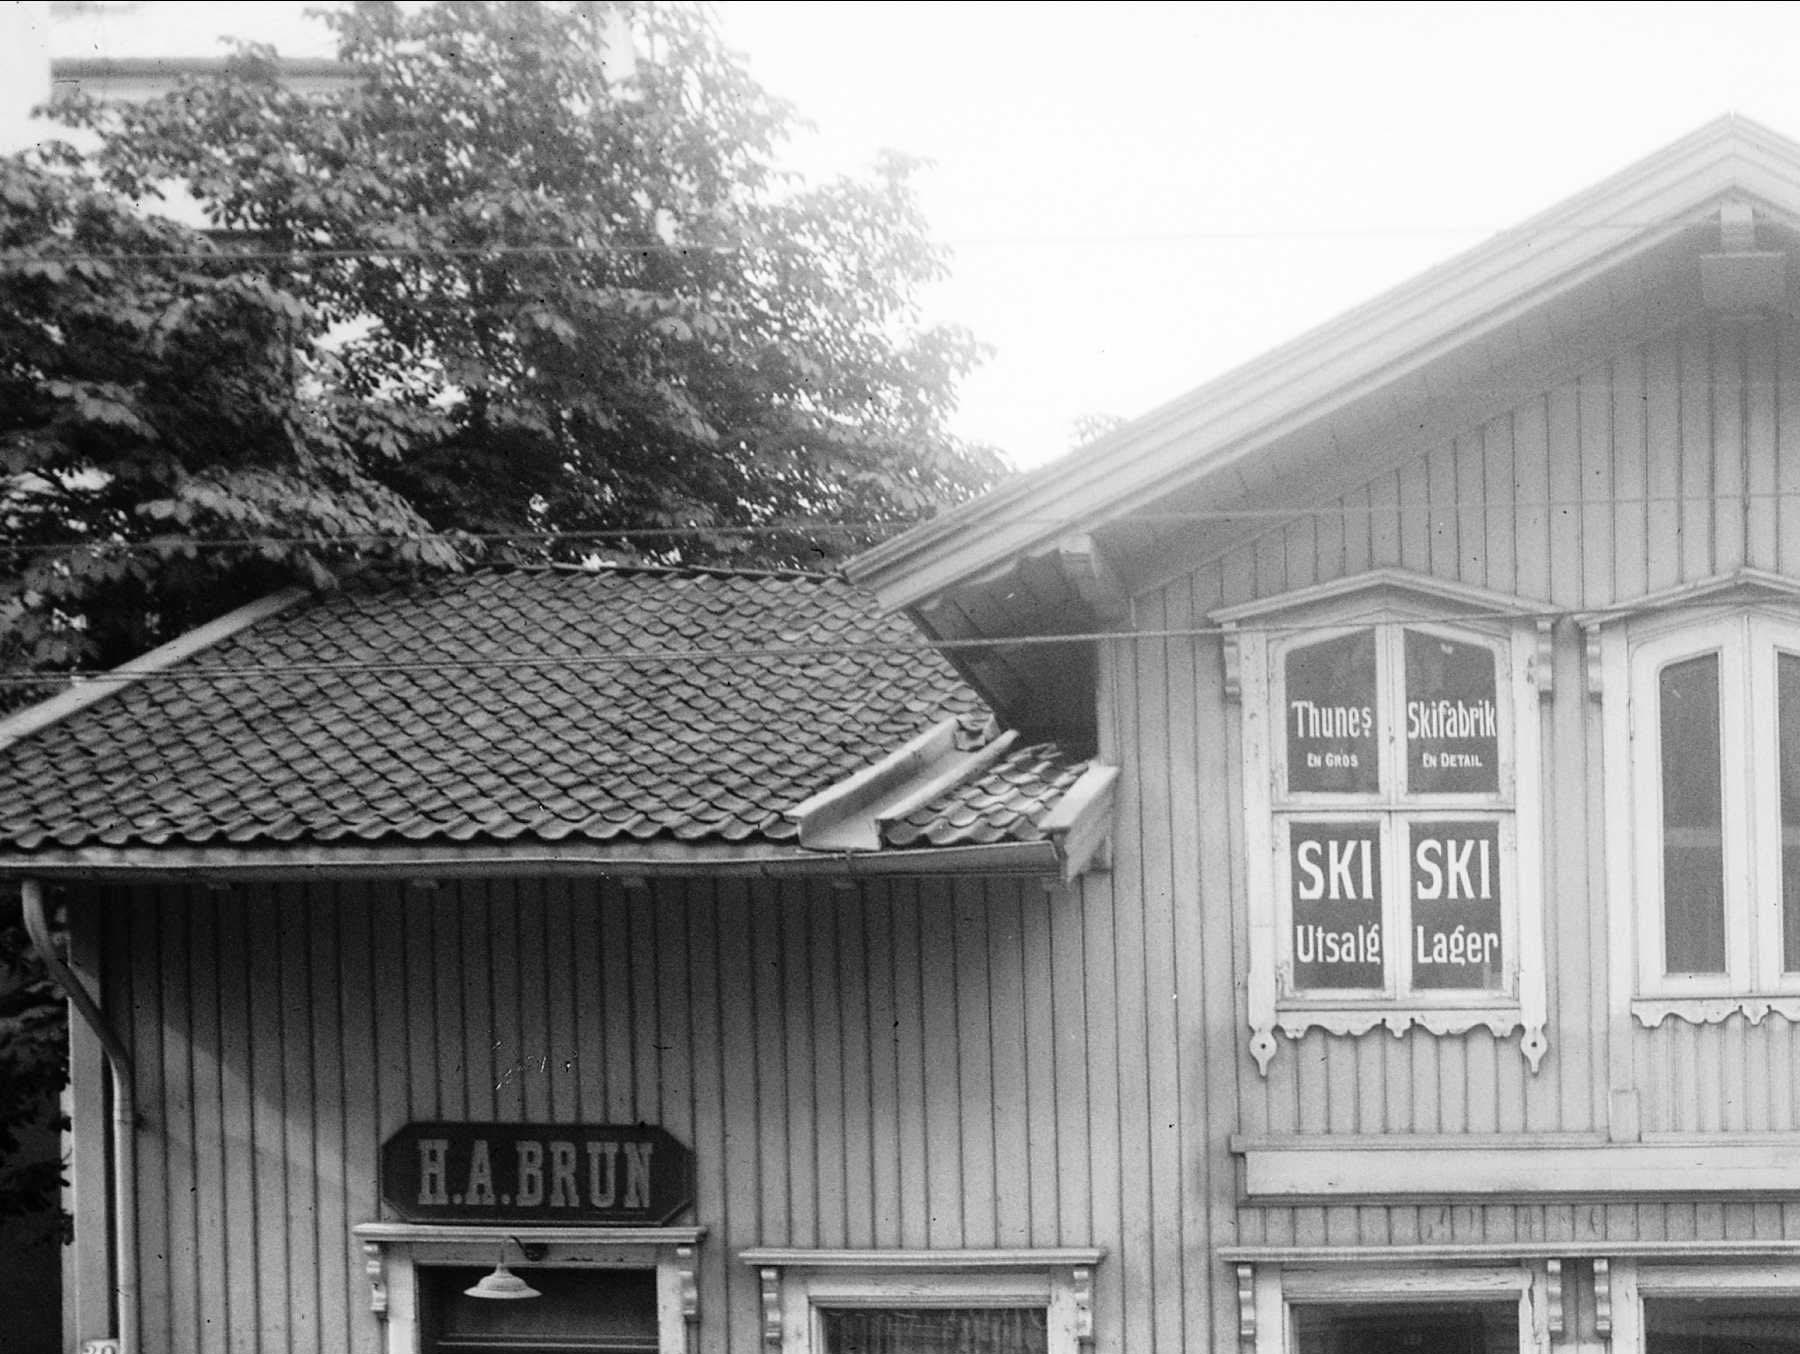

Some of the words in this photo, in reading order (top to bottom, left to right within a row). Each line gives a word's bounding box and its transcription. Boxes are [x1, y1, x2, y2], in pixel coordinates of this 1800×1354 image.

[1291, 700, 1373, 739] Thunes
[1407, 700, 1497, 739] Skifabrik
[1298, 839, 1374, 900] SKI
[1416, 838, 1492, 900] SKI
[1296, 923, 1382, 965] Utsalg
[1416, 924, 1498, 966] Lager
